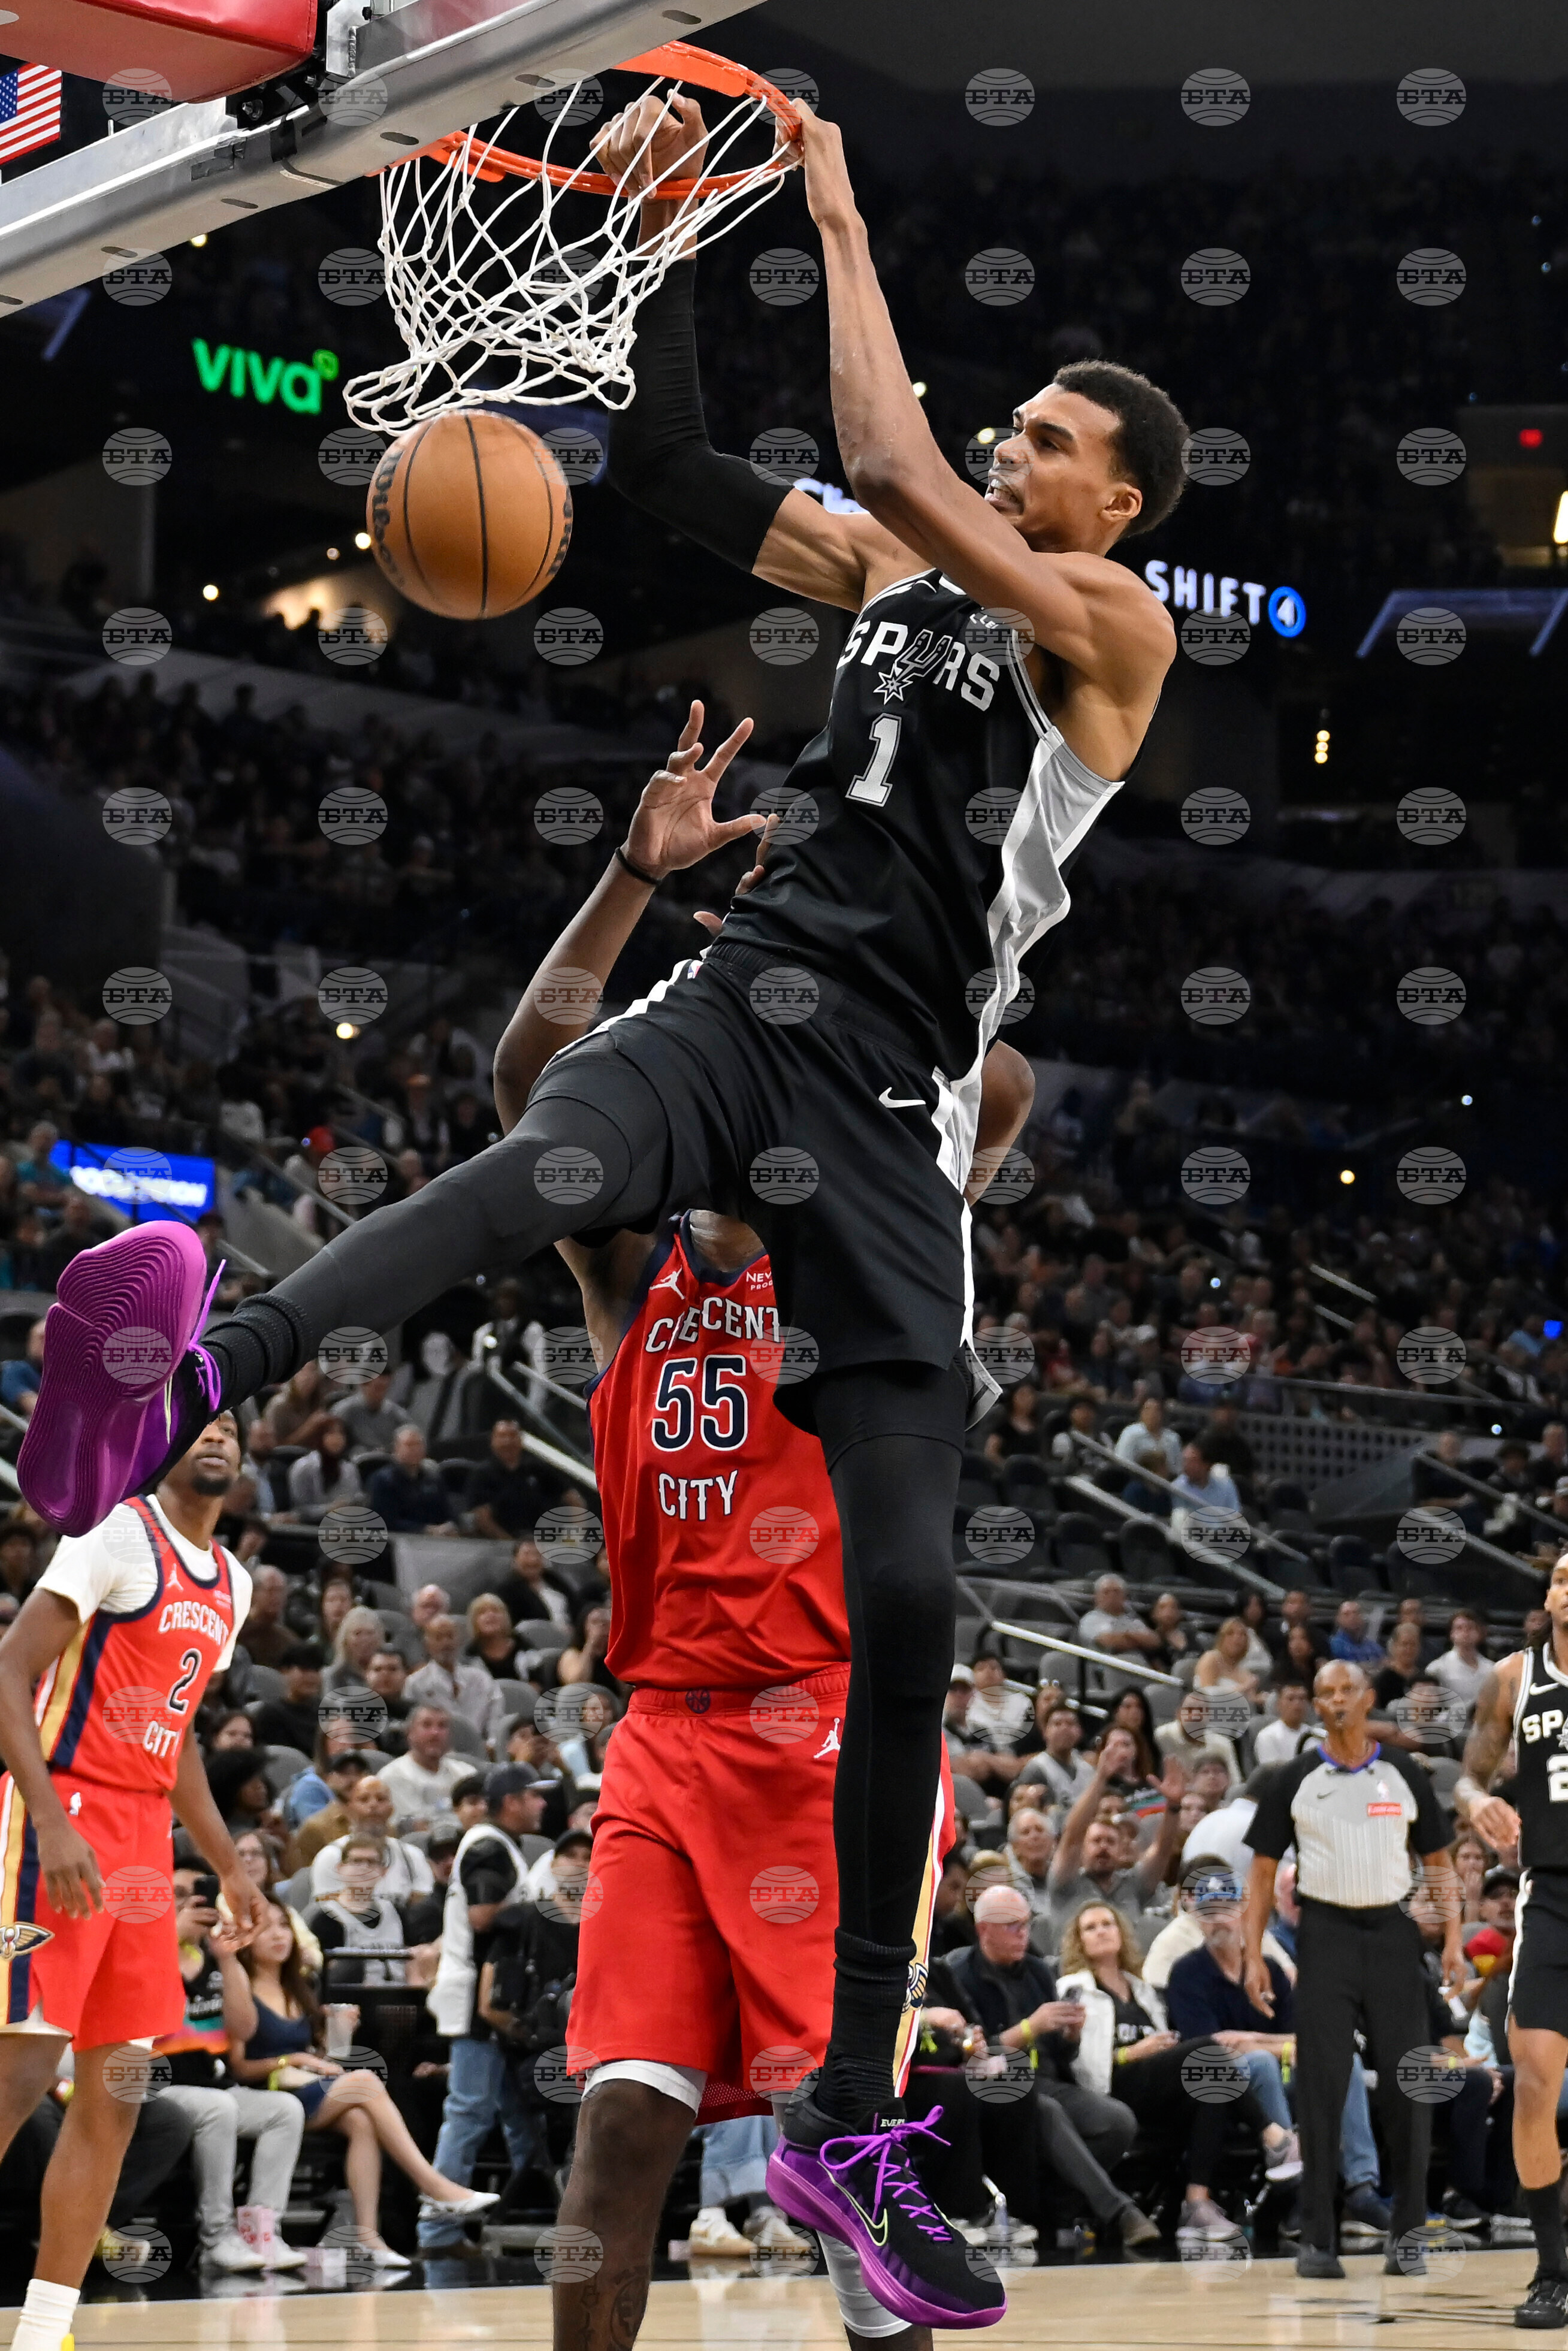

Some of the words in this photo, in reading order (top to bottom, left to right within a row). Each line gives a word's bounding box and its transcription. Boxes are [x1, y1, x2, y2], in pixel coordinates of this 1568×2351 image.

[845, 712, 902, 807] 1
[645, 1296, 780, 1353] CESCENT
[651, 1354, 748, 1452] 55
[658, 1469, 739, 1522] CITY
[166, 1648, 202, 1715] 2
